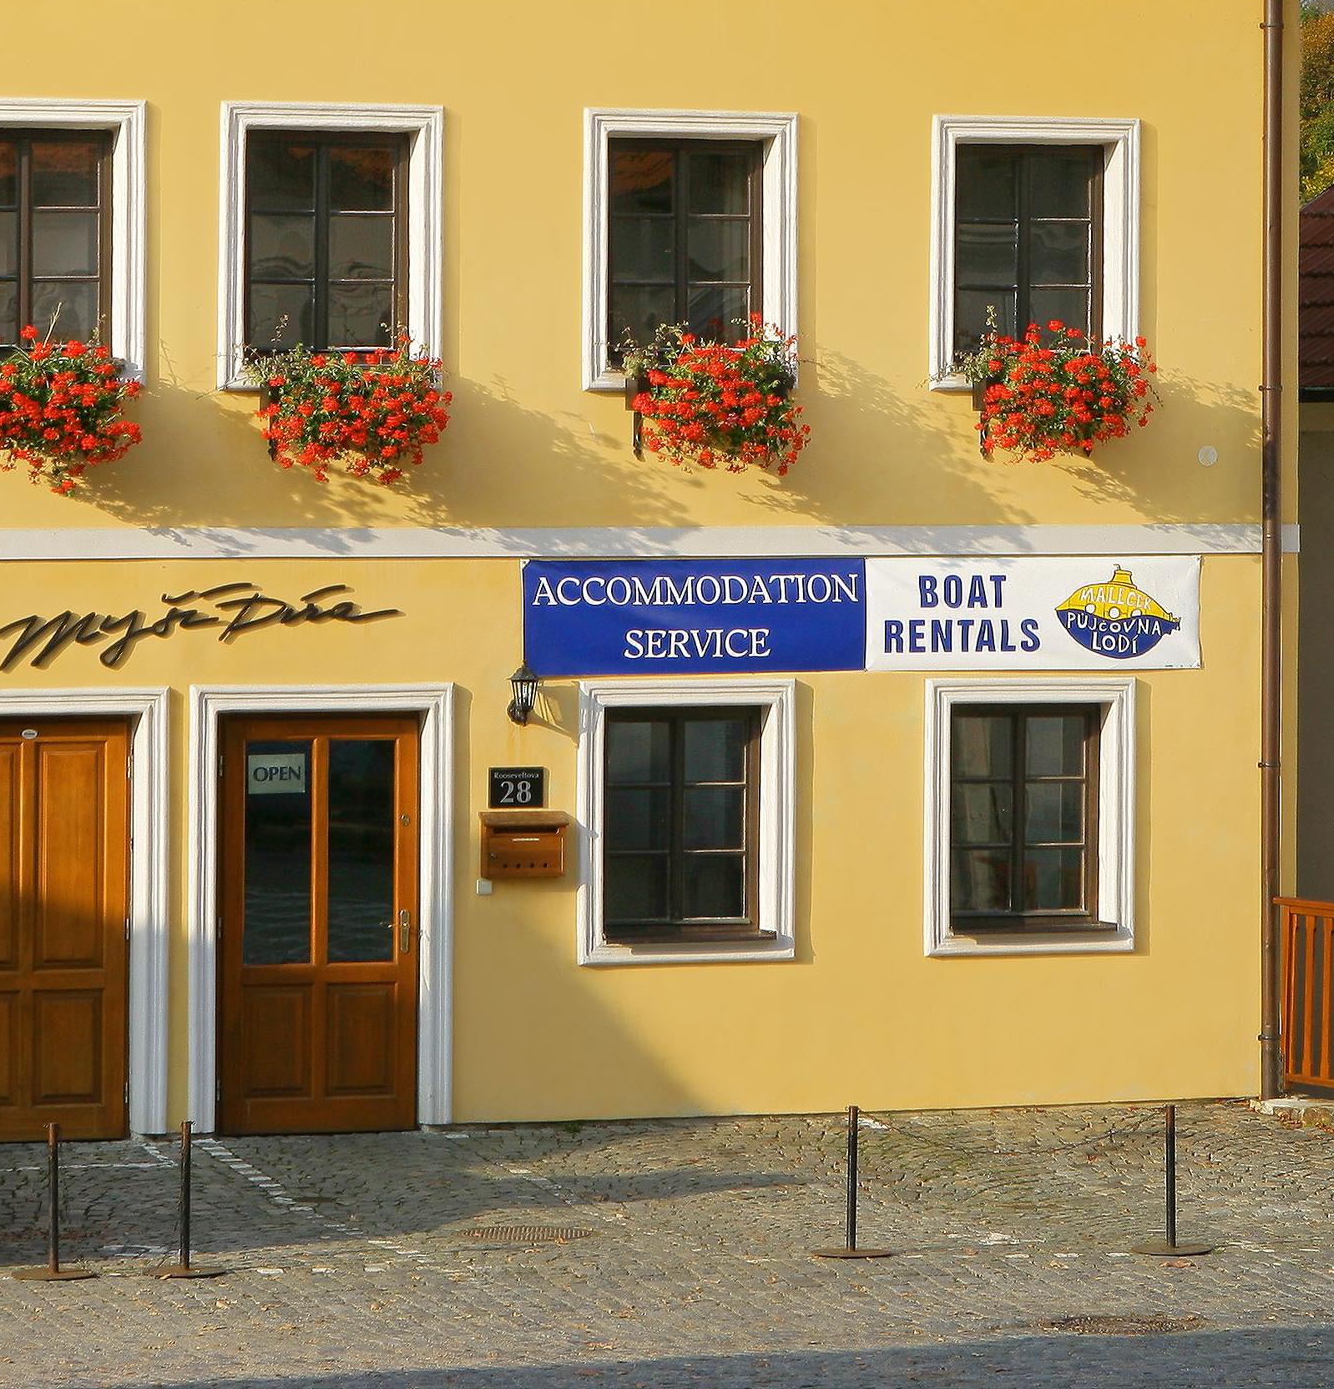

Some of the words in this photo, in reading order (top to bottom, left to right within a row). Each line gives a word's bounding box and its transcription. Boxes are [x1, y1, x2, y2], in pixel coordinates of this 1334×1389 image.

[532, 573, 860, 607] ACCOMMODATION
[918, 574, 1008, 610] BOAT
[883, 618, 1042, 654] RENTALS
[1067, 611, 1162, 637] PŮJČOVNA
[623, 627, 772, 659] SERVICE
[1090, 630, 1140, 654] LODÍ
[253, 765, 301, 782] OPEN
[493, 771, 540, 780] Rooseveltova
[500, 780, 532, 804] 28
